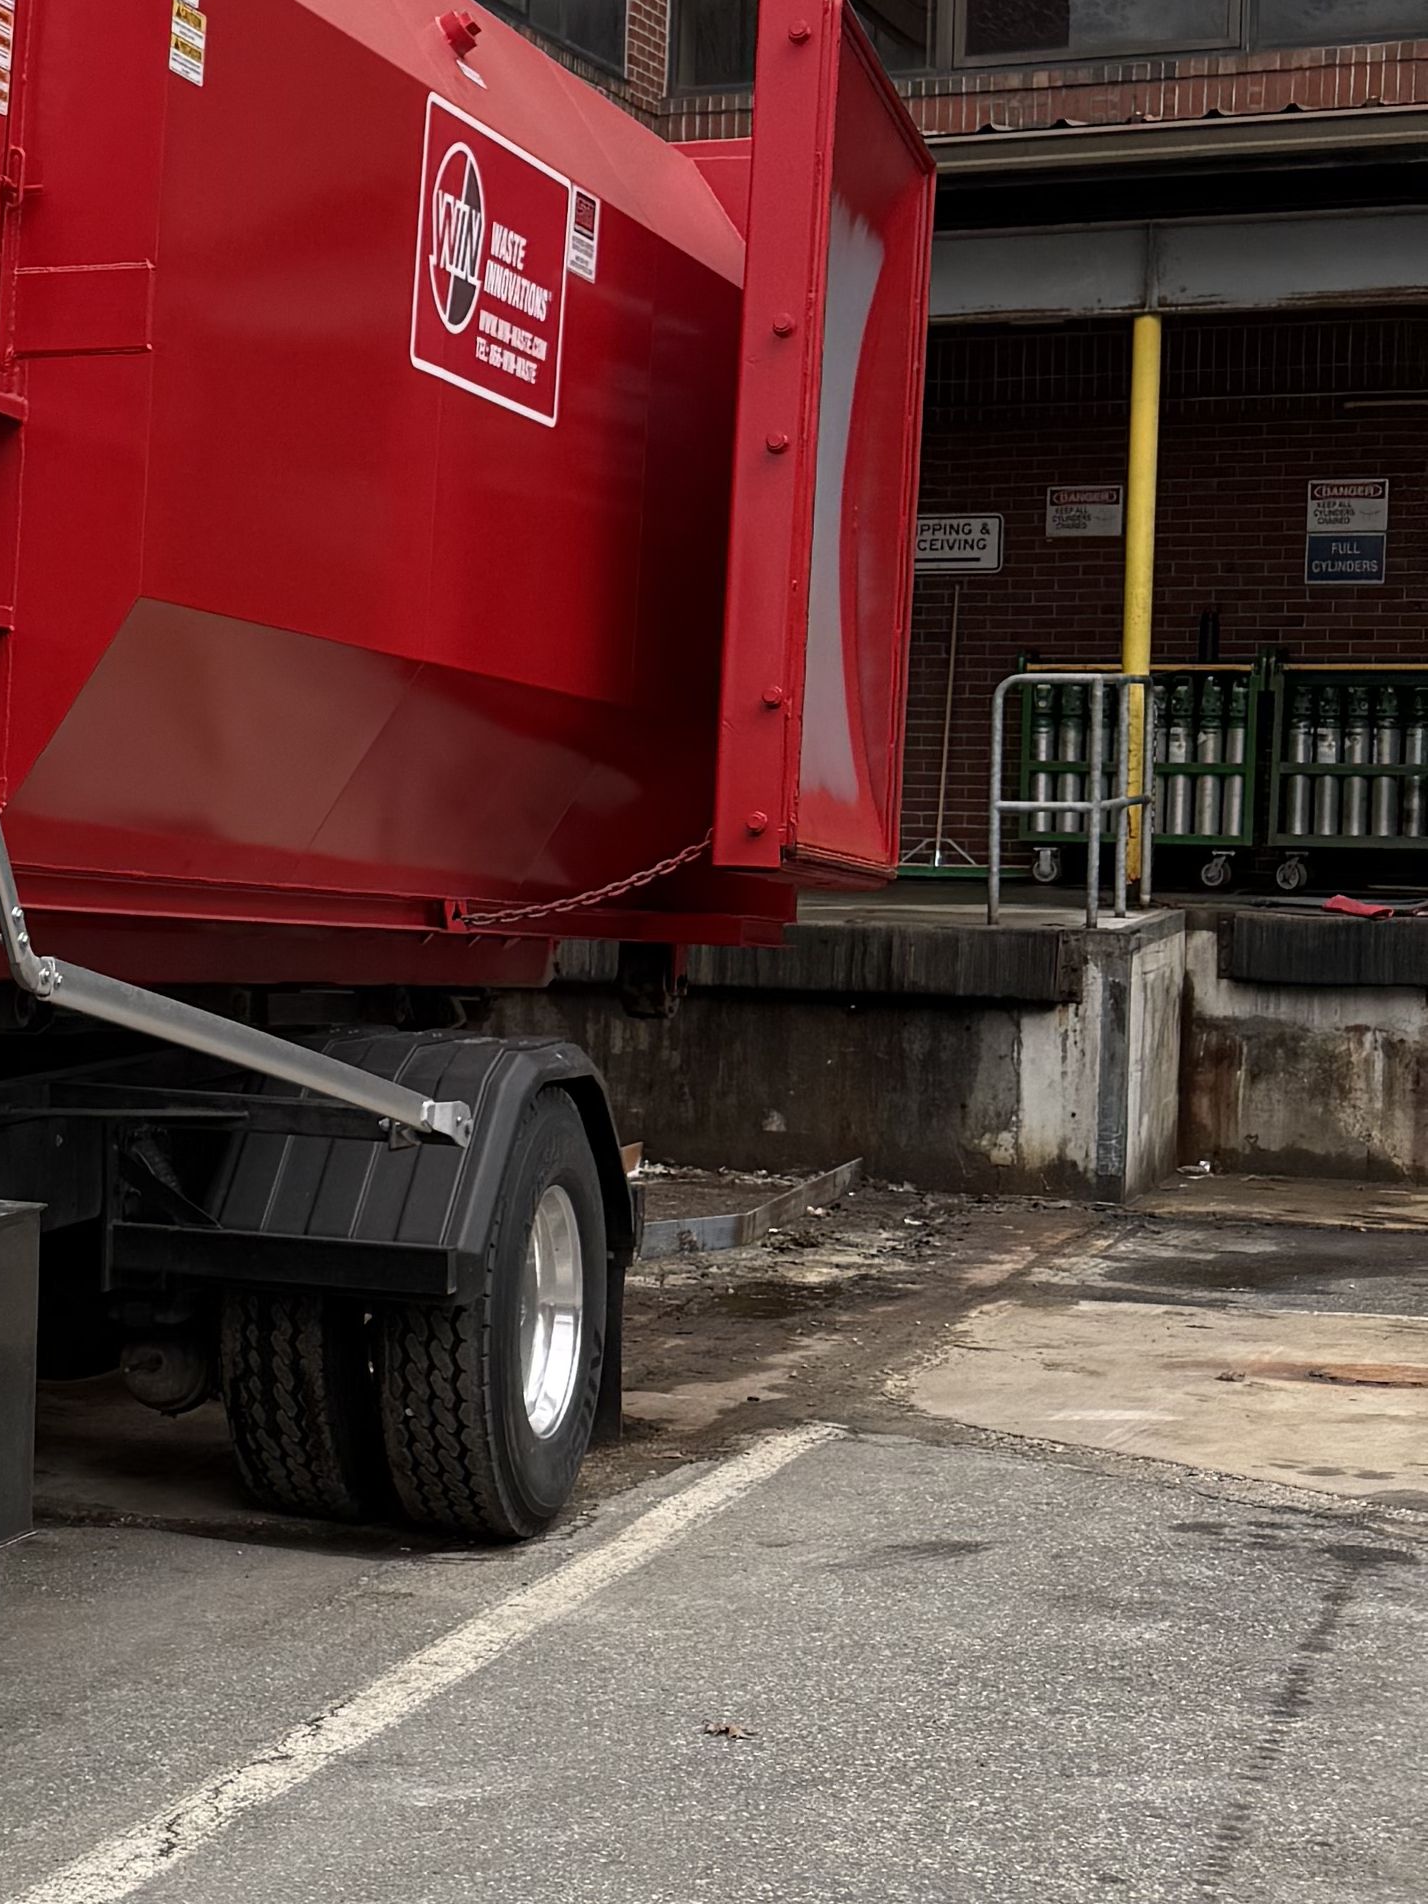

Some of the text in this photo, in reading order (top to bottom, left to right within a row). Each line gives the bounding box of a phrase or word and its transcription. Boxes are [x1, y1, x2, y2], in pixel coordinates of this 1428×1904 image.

[437, 188, 483, 286] WIN
[490, 221, 527, 271] WASTE
[483, 259, 548, 322] INNOVATIONS
[1060, 490, 1110, 503] DANGER
[1322, 485, 1375, 497] DANGER
[919, 523, 990, 536] PPING &
[917, 538, 987, 551] CEIVING
[1331, 541, 1361, 555] FULL
[1311, 560, 1379, 573] CYLINDERS
